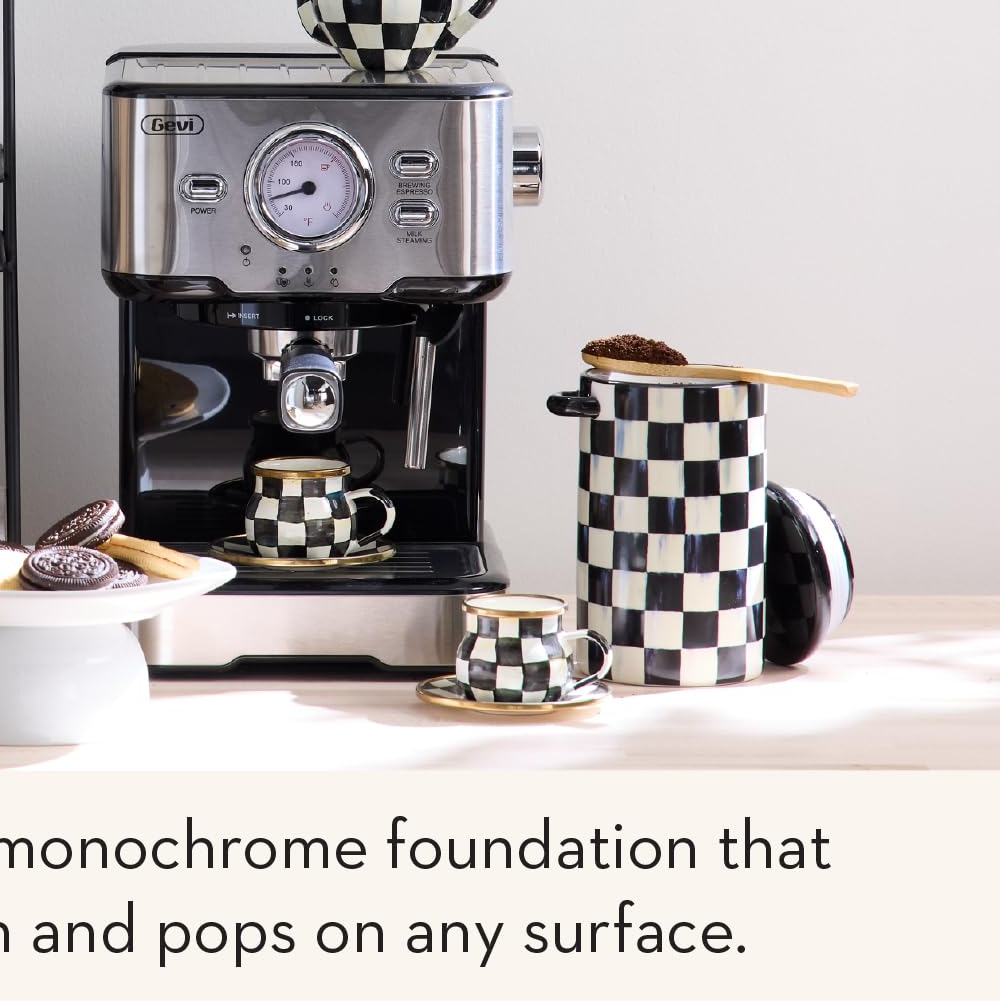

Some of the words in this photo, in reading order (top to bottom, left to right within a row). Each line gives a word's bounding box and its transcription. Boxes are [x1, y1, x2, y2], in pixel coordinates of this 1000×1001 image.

[151, 118, 194, 132] Gevi
[190, 207, 217, 215] POWER
[238, 312, 260, 320] INSERT
